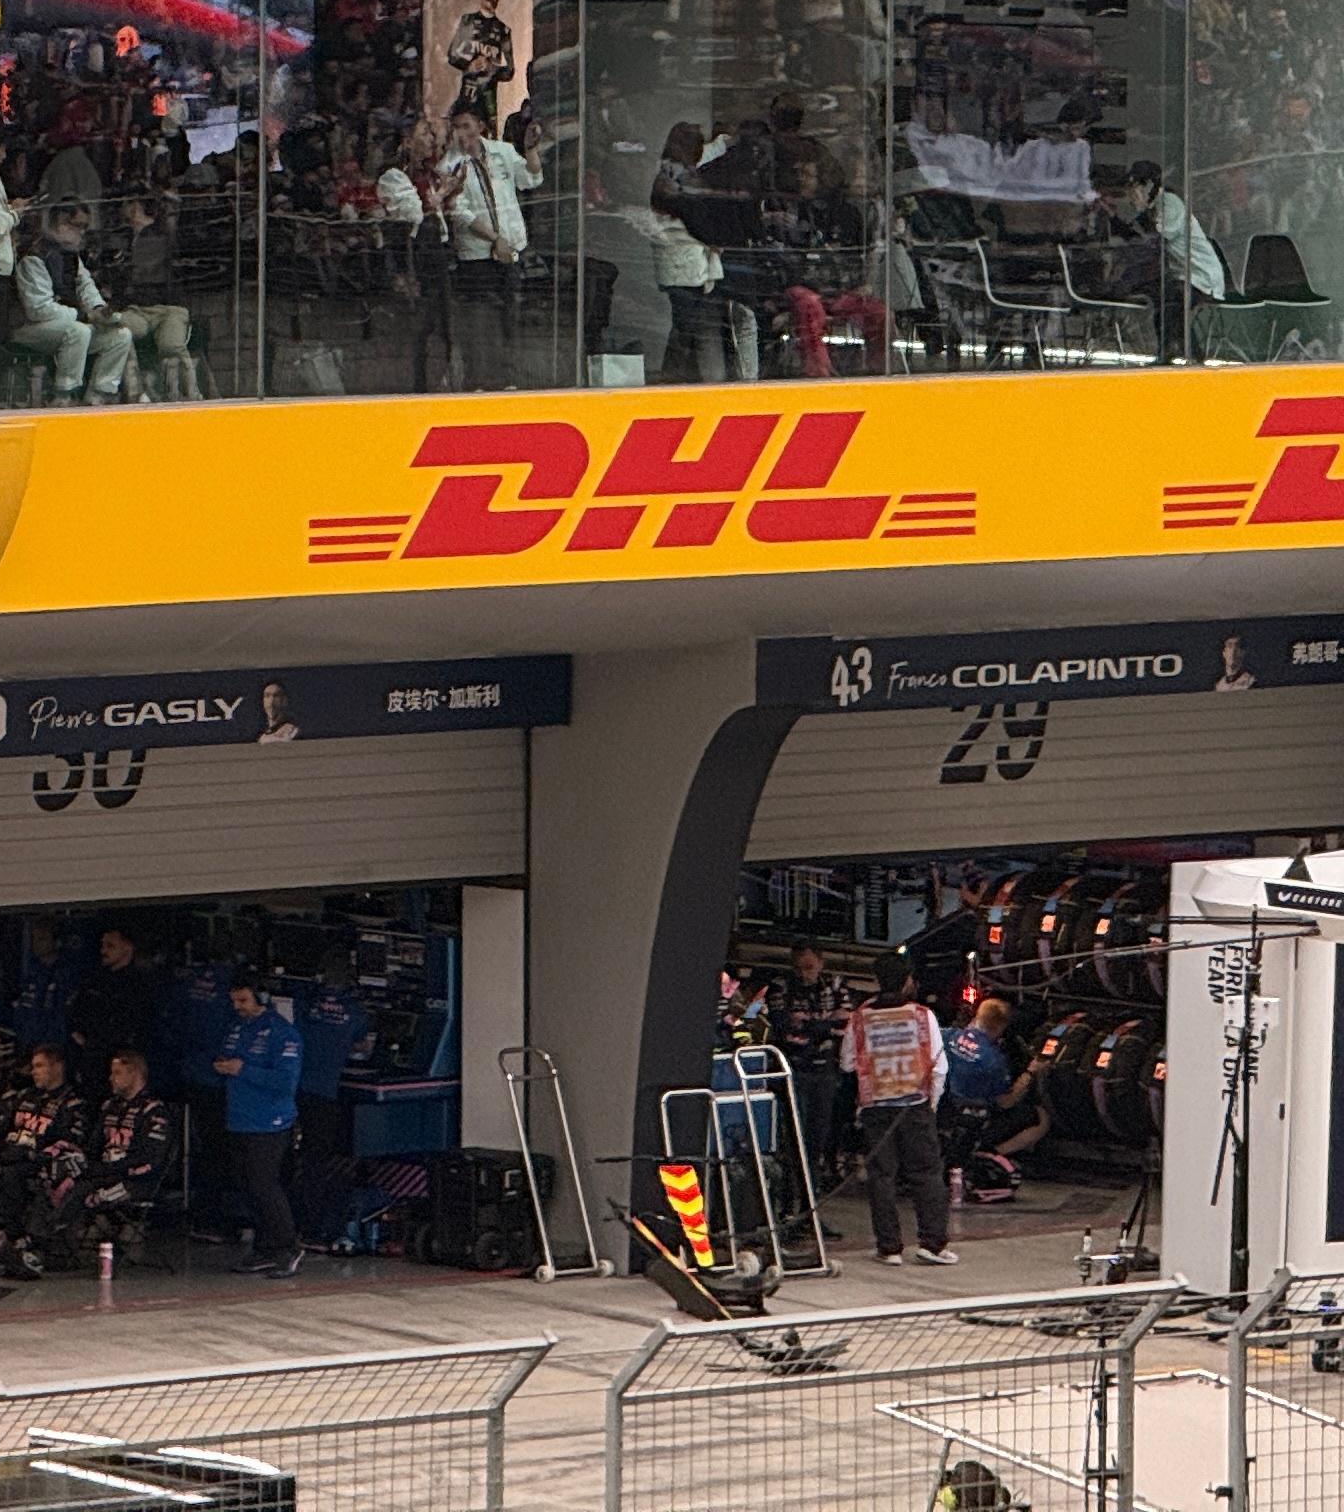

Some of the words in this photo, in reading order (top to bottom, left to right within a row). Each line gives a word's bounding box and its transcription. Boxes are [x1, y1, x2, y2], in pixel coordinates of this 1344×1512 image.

[399, 410, 893, 561] DHL
[831, 646, 872, 706] 43
[887, 661, 947, 700] Franco
[951, 654, 1183, 688] COLAPINTO
[103, 696, 244, 727] GASLY
